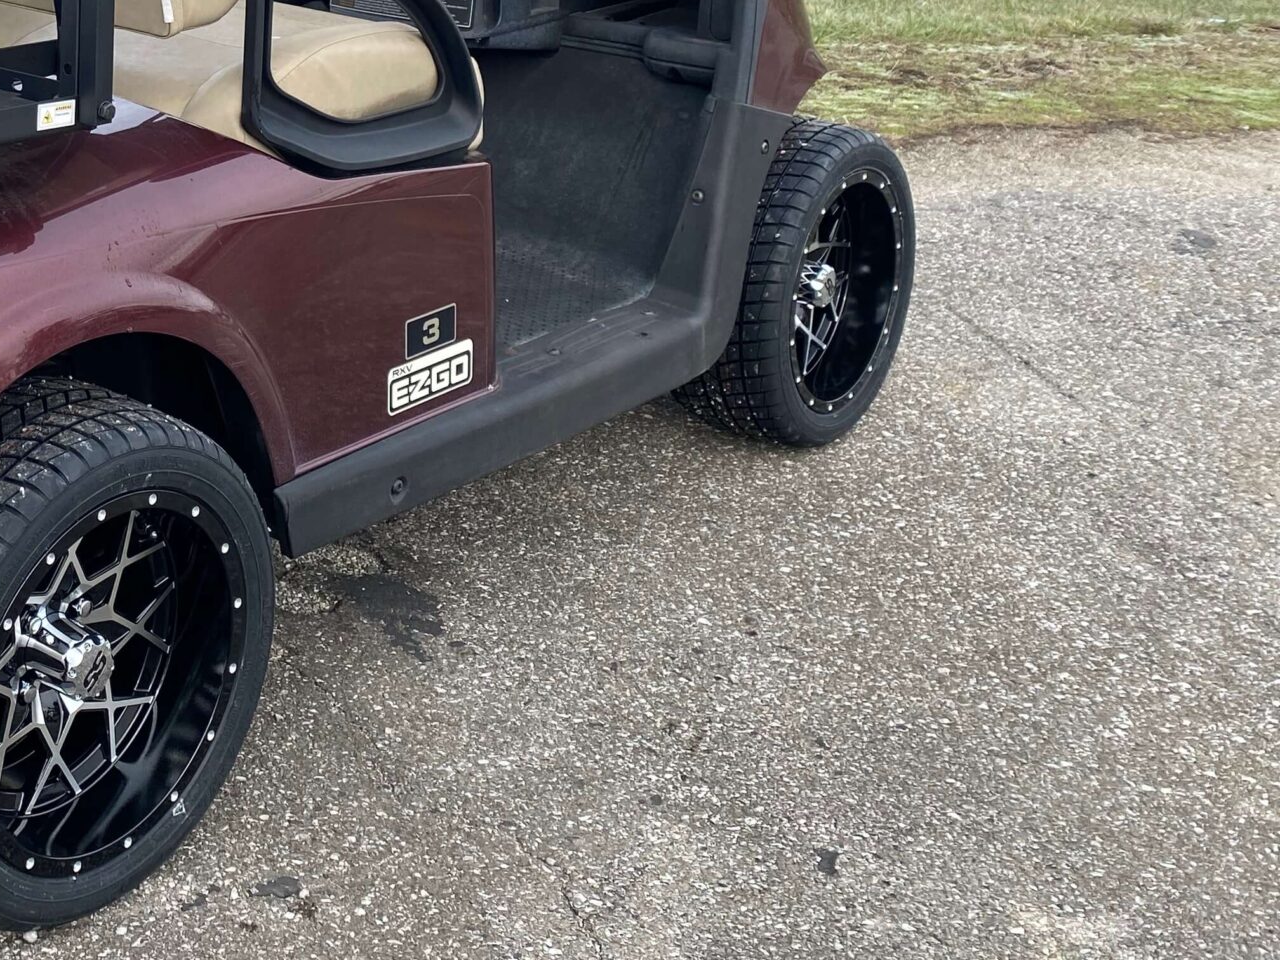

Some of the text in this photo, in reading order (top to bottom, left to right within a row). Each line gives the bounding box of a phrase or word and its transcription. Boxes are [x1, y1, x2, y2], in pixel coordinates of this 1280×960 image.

[422, 317, 440, 345] 3
[391, 353, 469, 410] EZGO
[392, 364, 414, 378] RXV
